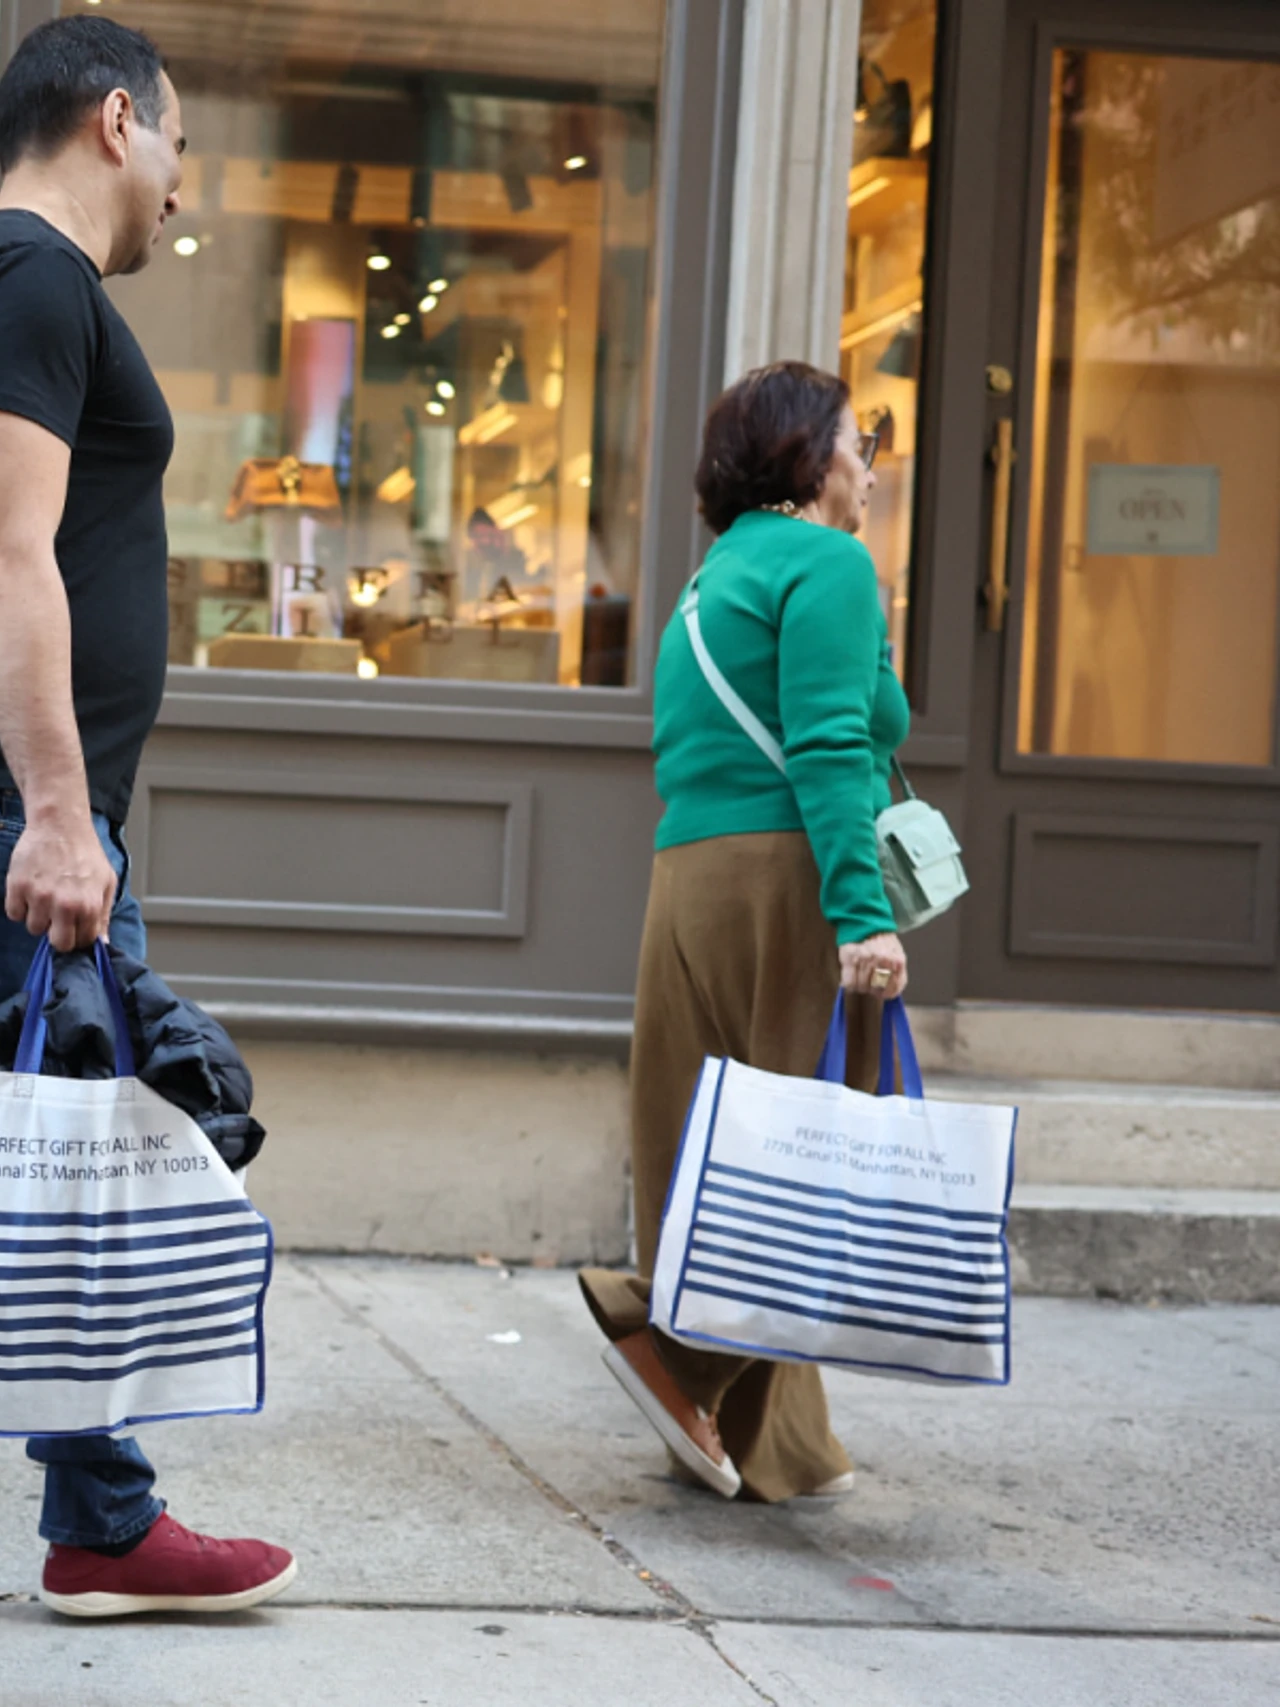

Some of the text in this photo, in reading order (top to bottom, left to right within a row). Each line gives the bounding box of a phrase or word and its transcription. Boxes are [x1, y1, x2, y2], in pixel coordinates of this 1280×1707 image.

[49, 1139, 86, 1156] GIFT
[113, 1136, 138, 1154] ALL
[142, 1134, 172, 1151] INC
[795, 1126, 848, 1147] PERFECT
[877, 1143, 902, 1158] FOR
[904, 1145, 925, 1161] ALL
[29, 1162, 48, 1181] ST,
[134, 1159, 157, 1176] NY
[162, 1155, 209, 1174] 10013
[795, 1144, 832, 1163] Canal
[919, 1166, 937, 1180] NY
